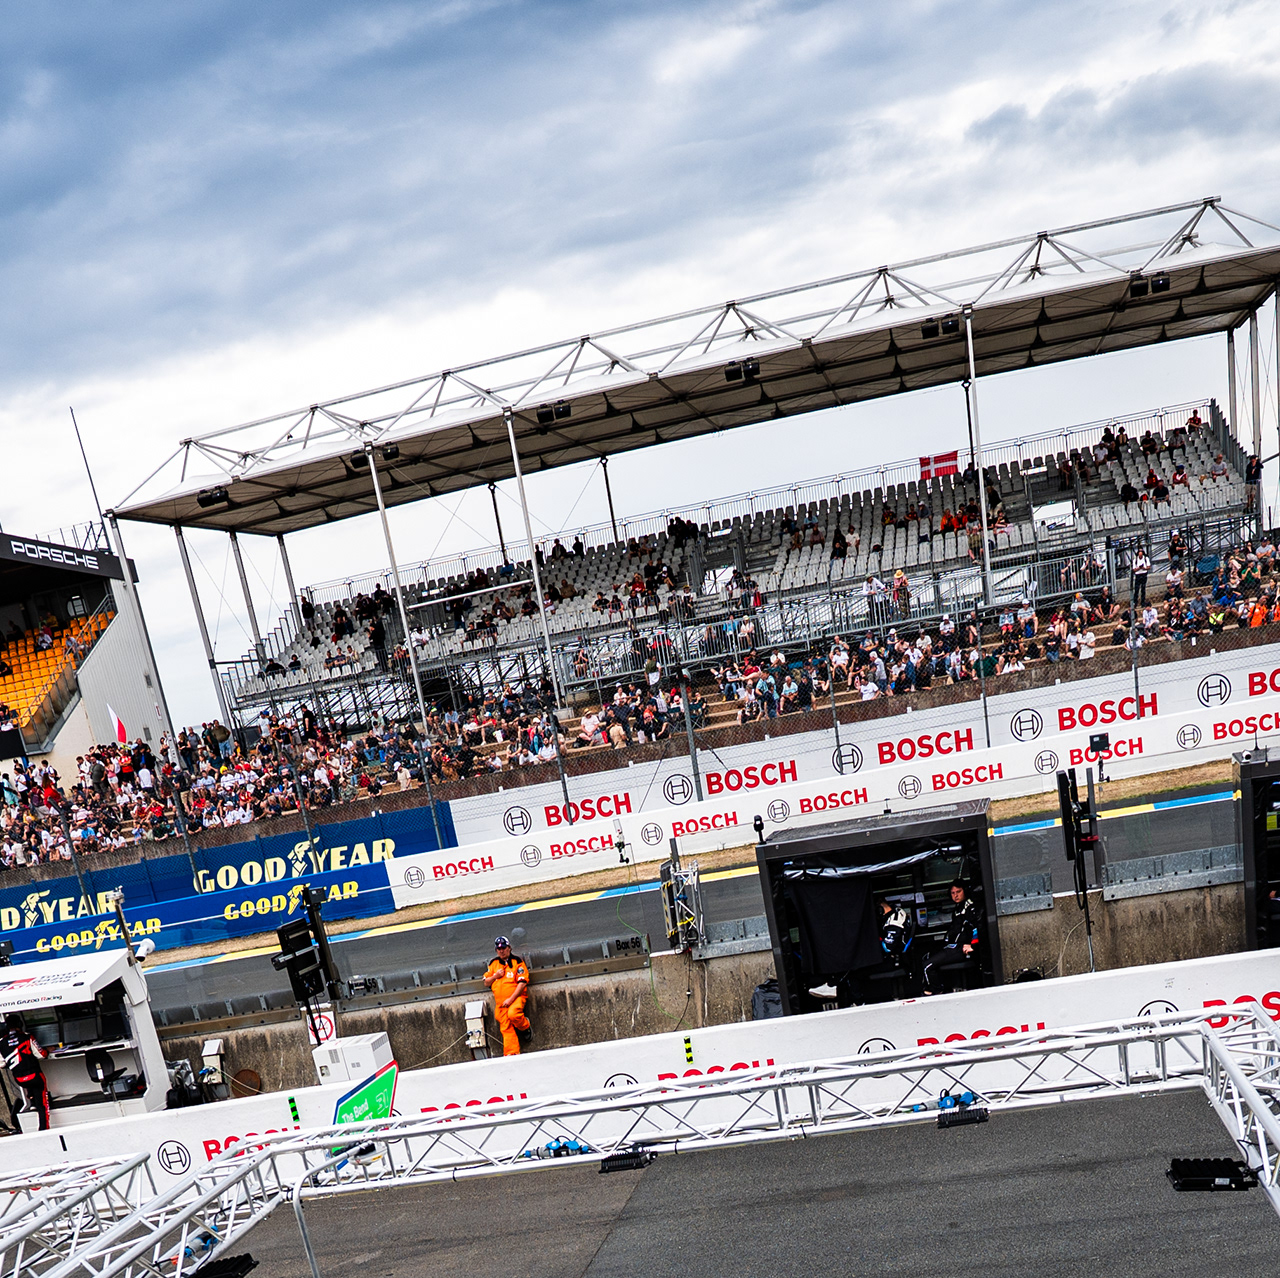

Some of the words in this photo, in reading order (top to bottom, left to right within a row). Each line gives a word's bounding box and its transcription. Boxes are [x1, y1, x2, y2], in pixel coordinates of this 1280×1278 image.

[11, 539, 99, 570] PORSCHE
[1058, 693, 1158, 730] BOSCH
[878, 728, 974, 764] BOSCH
[706, 760, 798, 795] BOSCH
[932, 763, 1003, 790] BOSCH
[545, 792, 632, 827] BOSCH
[799, 787, 868, 813] BOSCH
[672, 811, 738, 836] BOSCH
[550, 834, 613, 859] BOSCH
[193, 837, 395, 894] GOODYEAR
[432, 856, 494, 881] BOSCH
